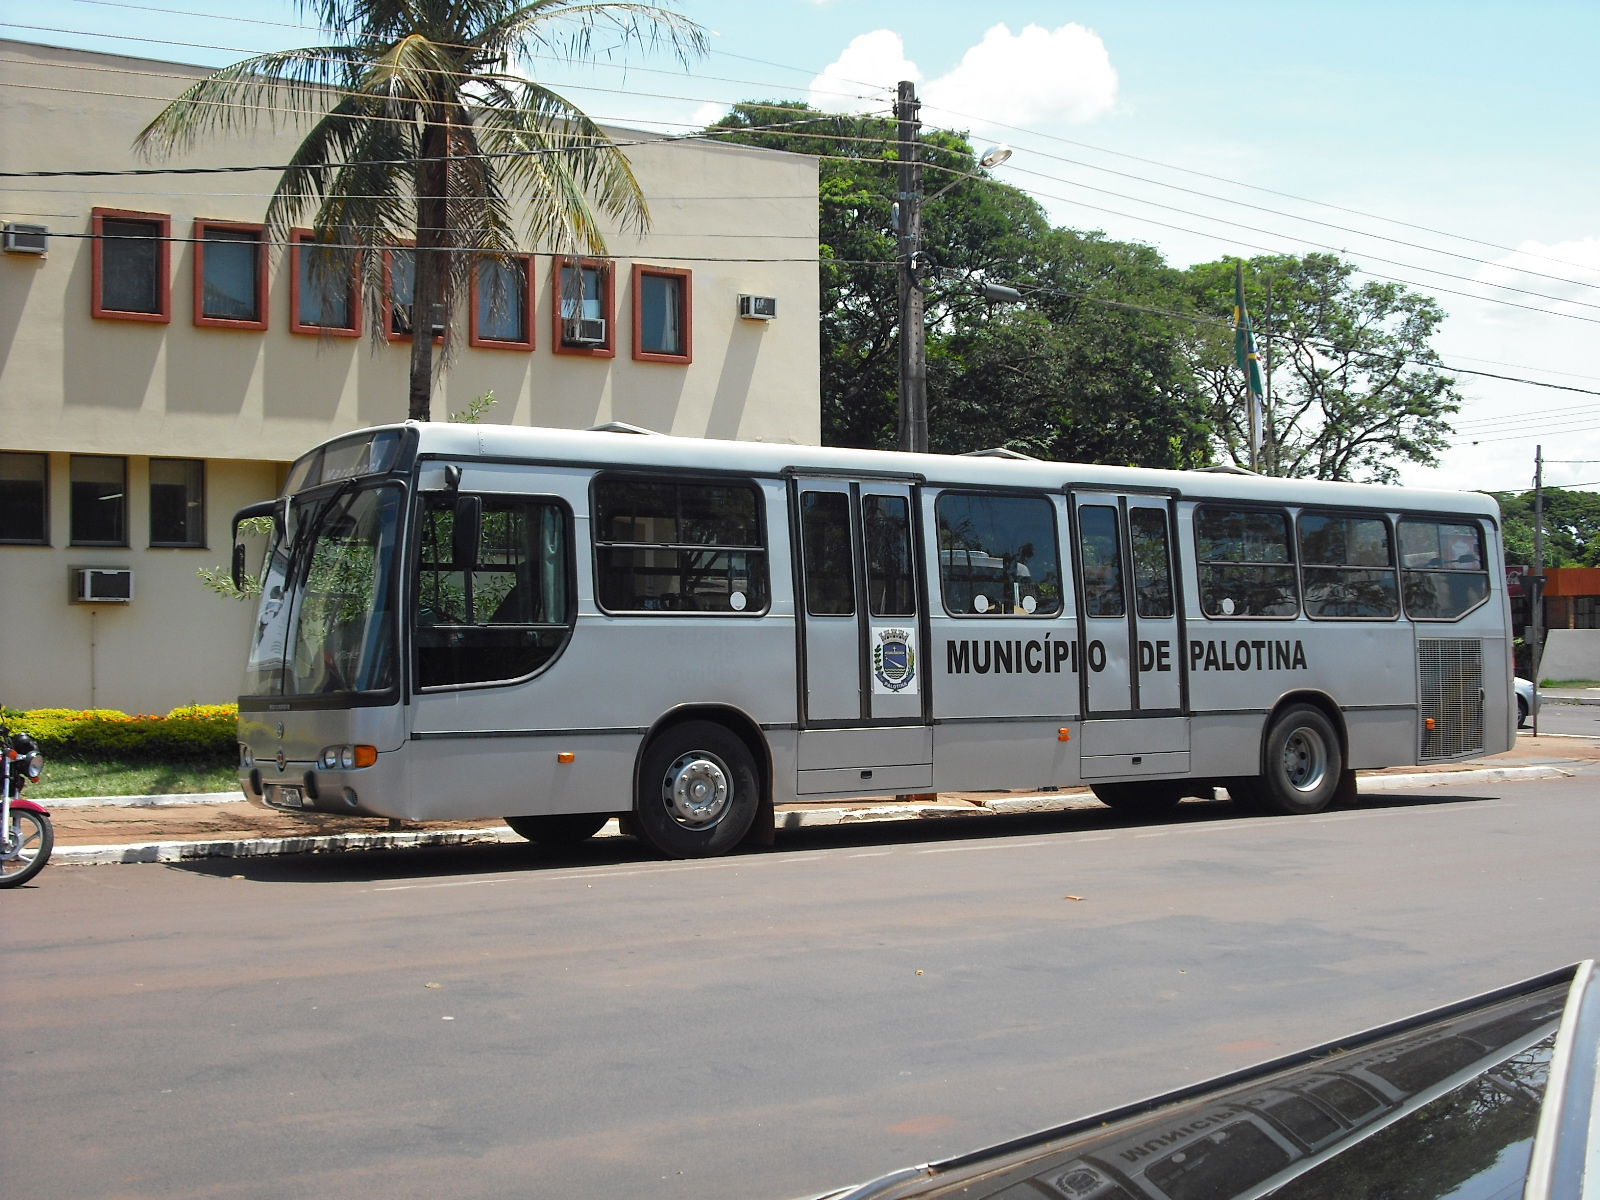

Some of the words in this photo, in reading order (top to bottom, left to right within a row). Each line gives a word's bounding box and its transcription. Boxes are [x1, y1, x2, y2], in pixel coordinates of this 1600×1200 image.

[947, 632, 1107, 674] MUNICÍPIO
[1138, 640, 1171, 672] DE
[1190, 640, 1307, 671] PALOTINA
[883, 681, 908, 689] PALOTINA
